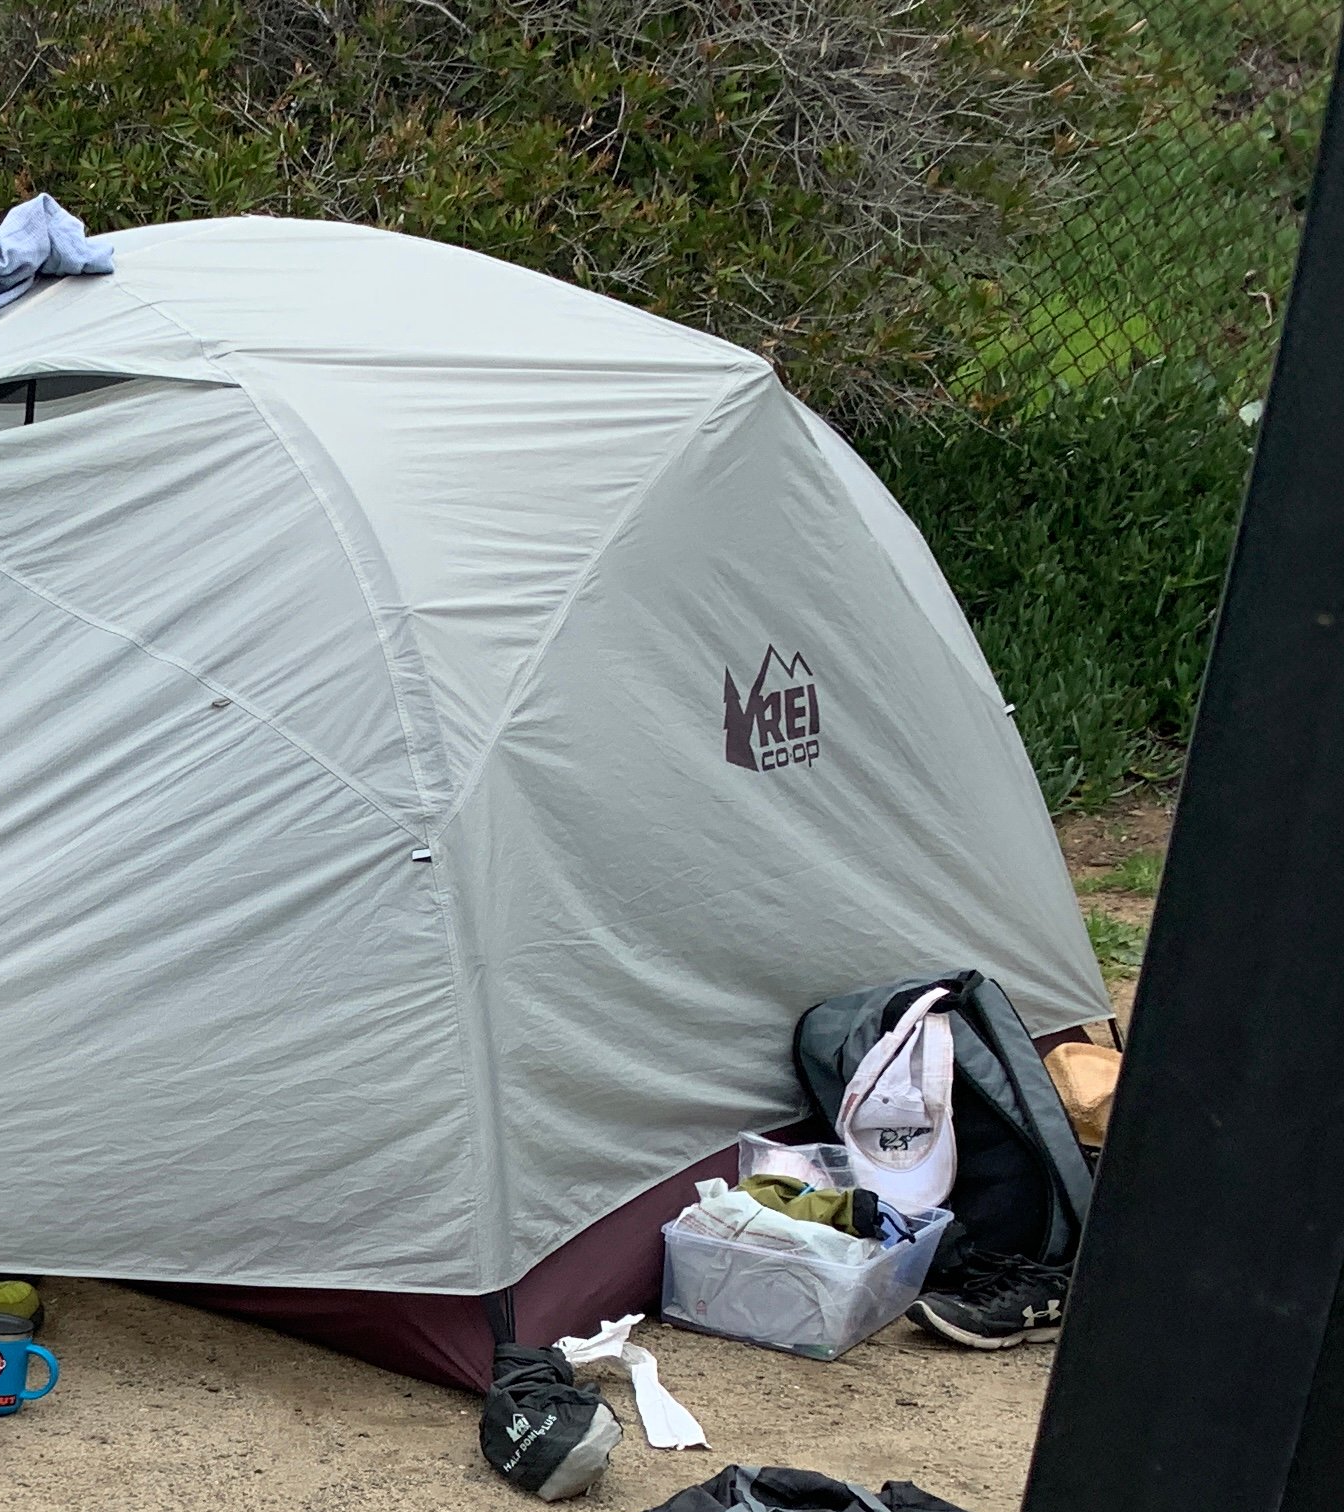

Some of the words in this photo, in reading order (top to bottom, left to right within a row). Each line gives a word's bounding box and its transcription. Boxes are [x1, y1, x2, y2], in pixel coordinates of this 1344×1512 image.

[756, 684, 820, 747] REI
[503, 1450, 521, 1472] HALF
[538, 1415, 557, 1436] PLUS
